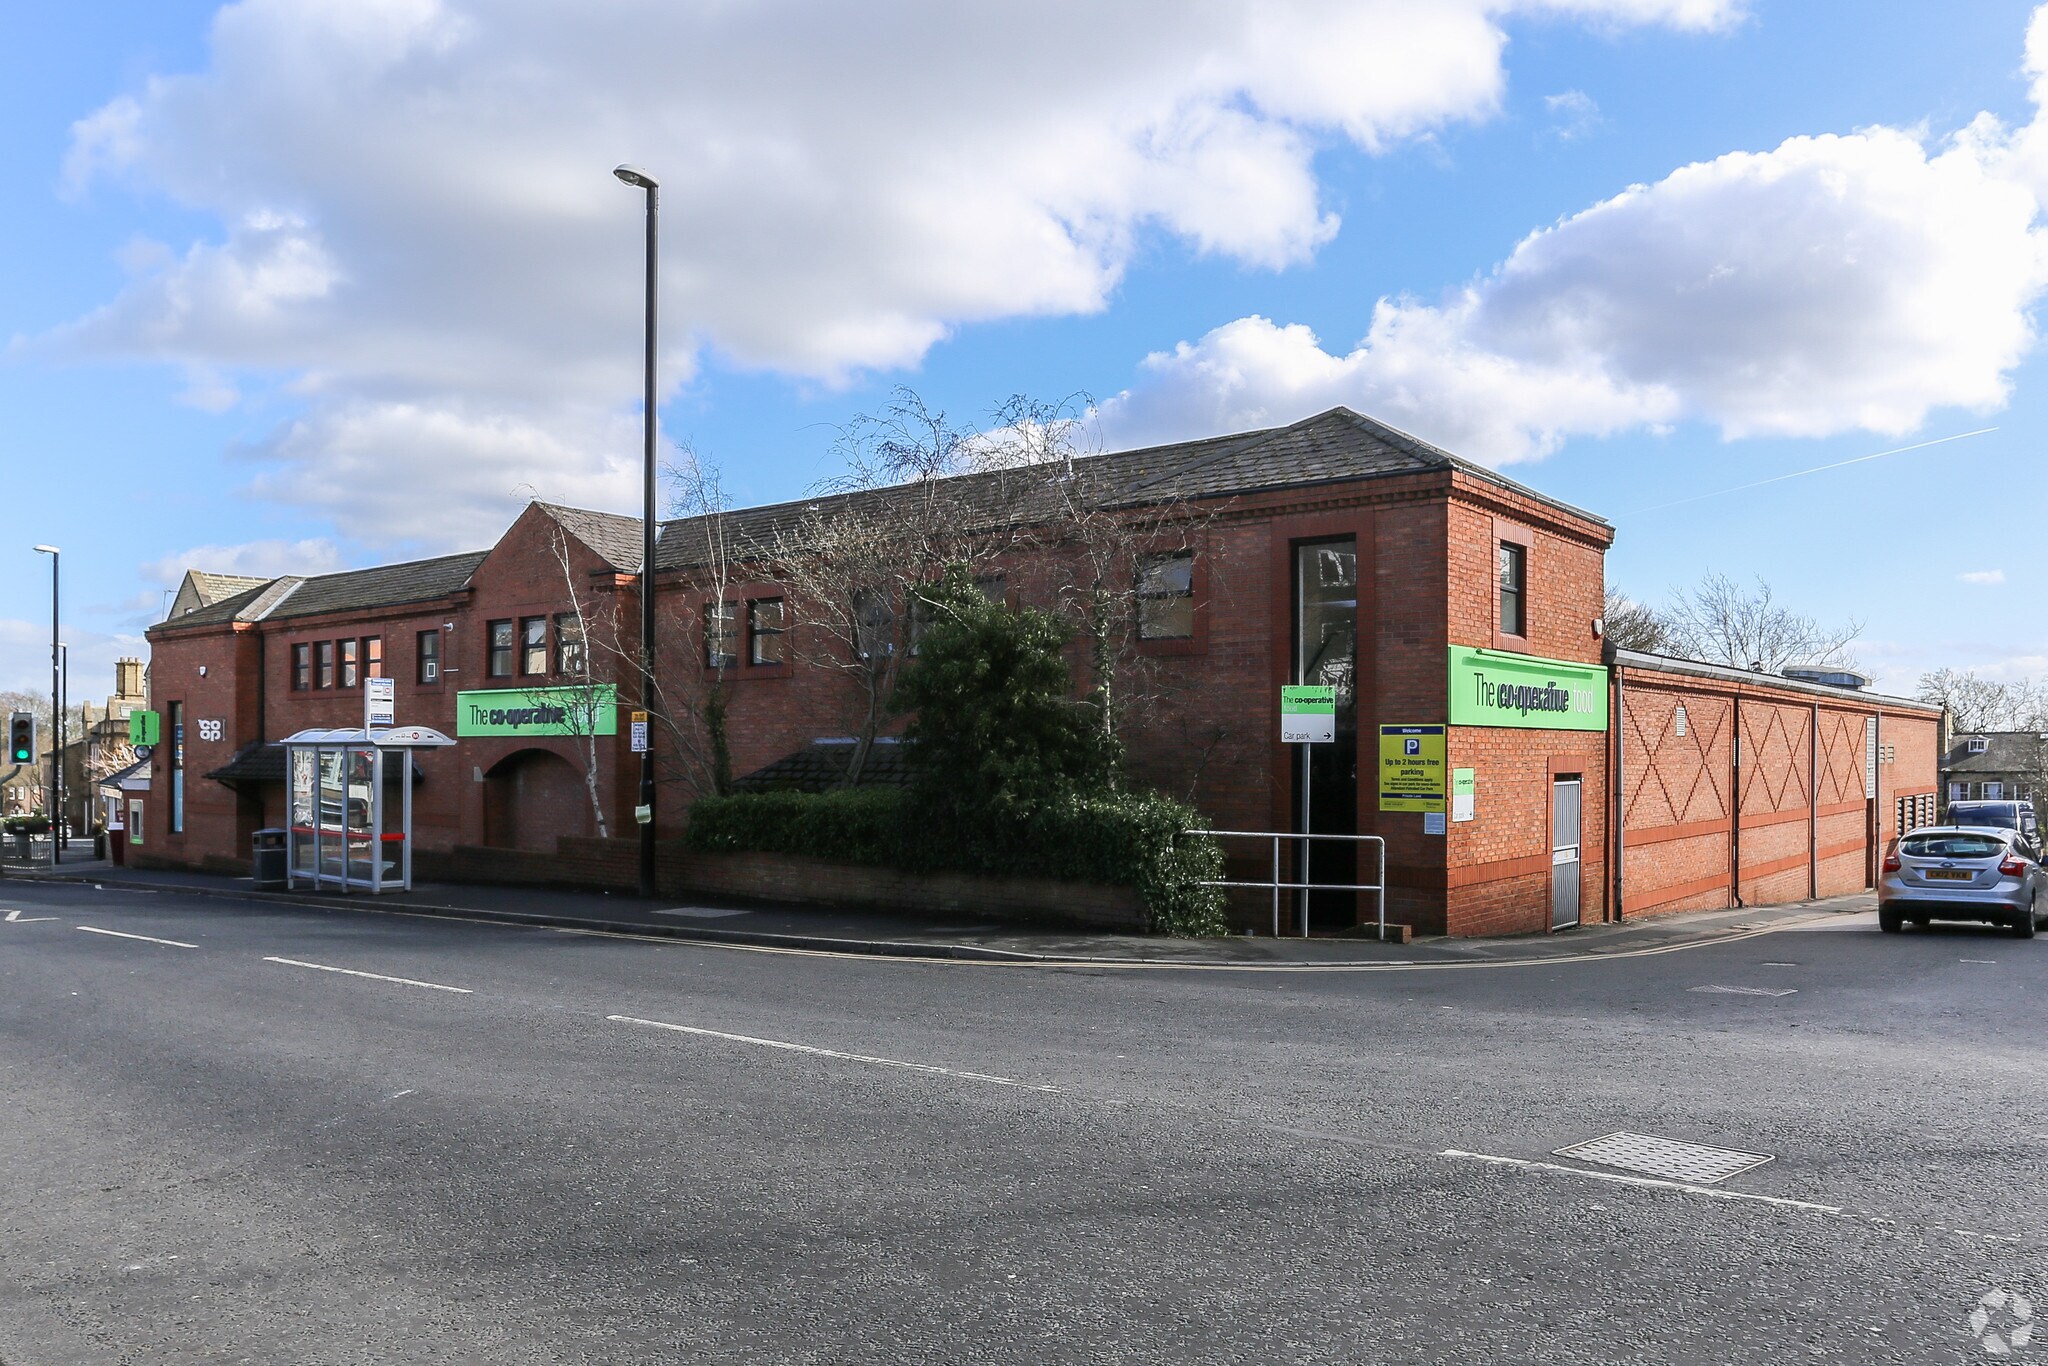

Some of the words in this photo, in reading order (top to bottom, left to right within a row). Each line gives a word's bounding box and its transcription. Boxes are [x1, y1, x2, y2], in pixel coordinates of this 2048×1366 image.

[1474, 672, 1495, 707] The
[1497, 681, 1569, 717] co-operative
[1573, 683, 1593, 713] food
[469, 705, 488, 725] The
[489, 702, 566, 729] co-operative
[1296, 732, 1311, 740] park
[1407, 740, 1418, 754] P
